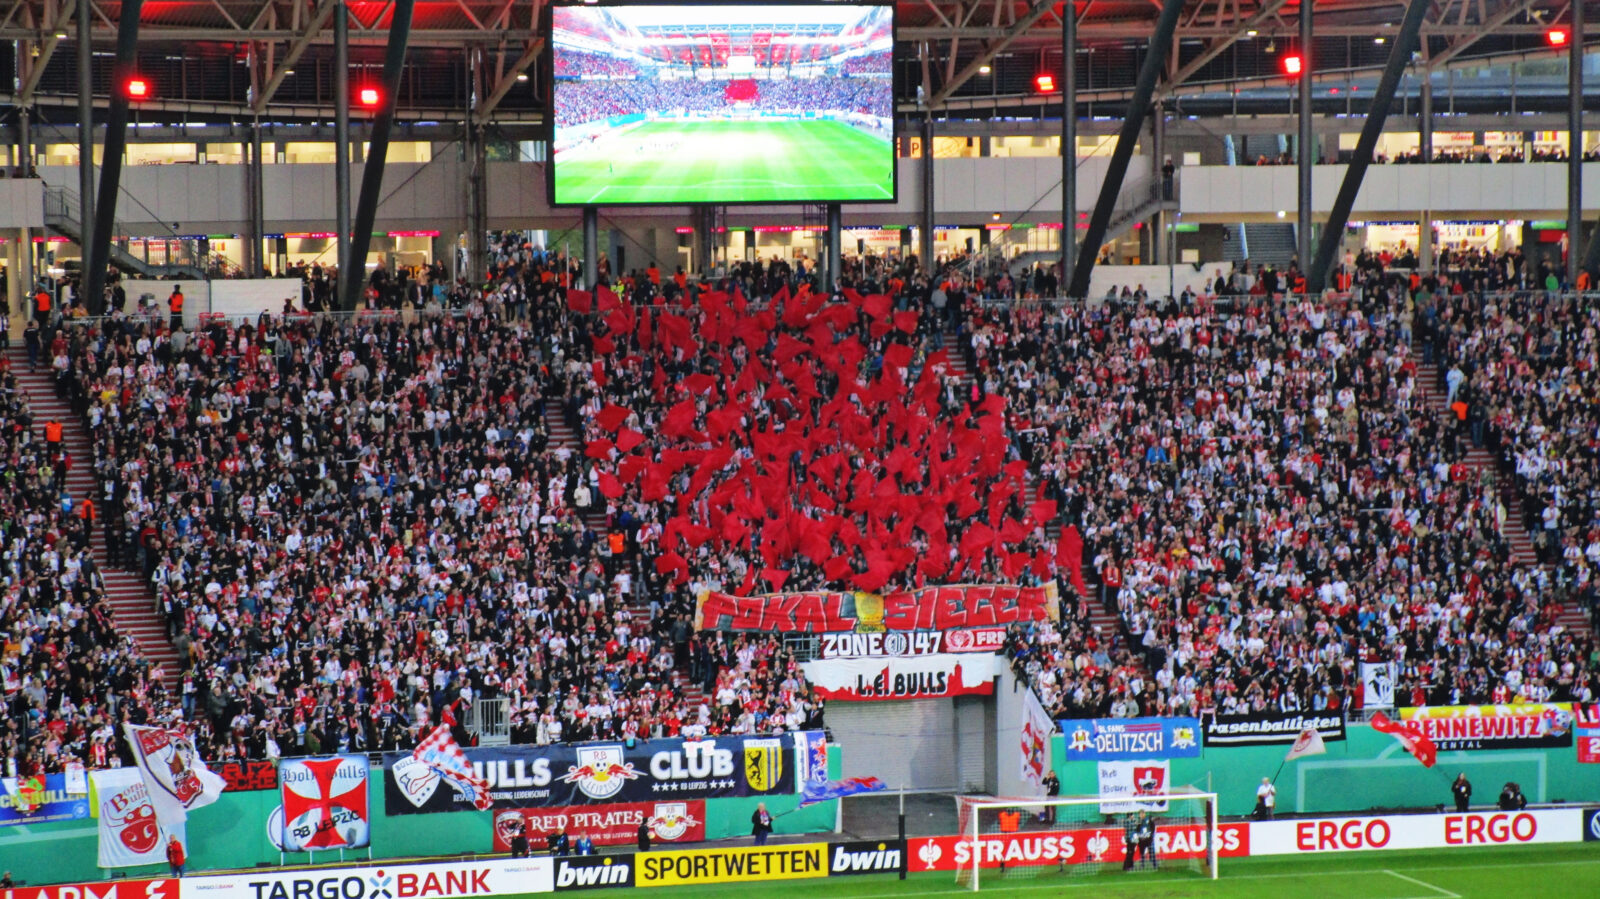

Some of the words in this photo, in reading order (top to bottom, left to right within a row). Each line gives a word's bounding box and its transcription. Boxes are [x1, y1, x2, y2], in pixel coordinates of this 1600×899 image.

[702, 592, 859, 633] POKAL
[884, 586, 1048, 631] SIEGER
[823, 632, 883, 656] ZONE
[908, 631, 943, 655] 147
[894, 671, 947, 696] BULLS
[1208, 715, 1342, 734] rasenballisten
[1096, 731, 1163, 753] DELITZSCH
[472, 757, 552, 789] ULLS
[650, 748, 735, 780] CLUB
[593, 751, 608, 761] RB
[514, 789, 551, 799] LEIDENSCHAFT
[584, 779, 618, 796] LEIPZIG
[293, 825, 311, 839] RB
[528, 814, 569, 832] RED
[571, 810, 644, 830] PIRATES
[1444, 813, 1537, 844] ERGO
[1121, 828, 1240, 855] RAUSS
[1296, 819, 1391, 851] ERGO
[832, 843, 900, 873] bwin
[954, 836, 1075, 864] STRAUSS
[556, 857, 629, 888] bwin
[644, 849, 820, 880] SPORTWETTEN
[249, 876, 365, 899] TARGO
[398, 869, 492, 898] BANK
